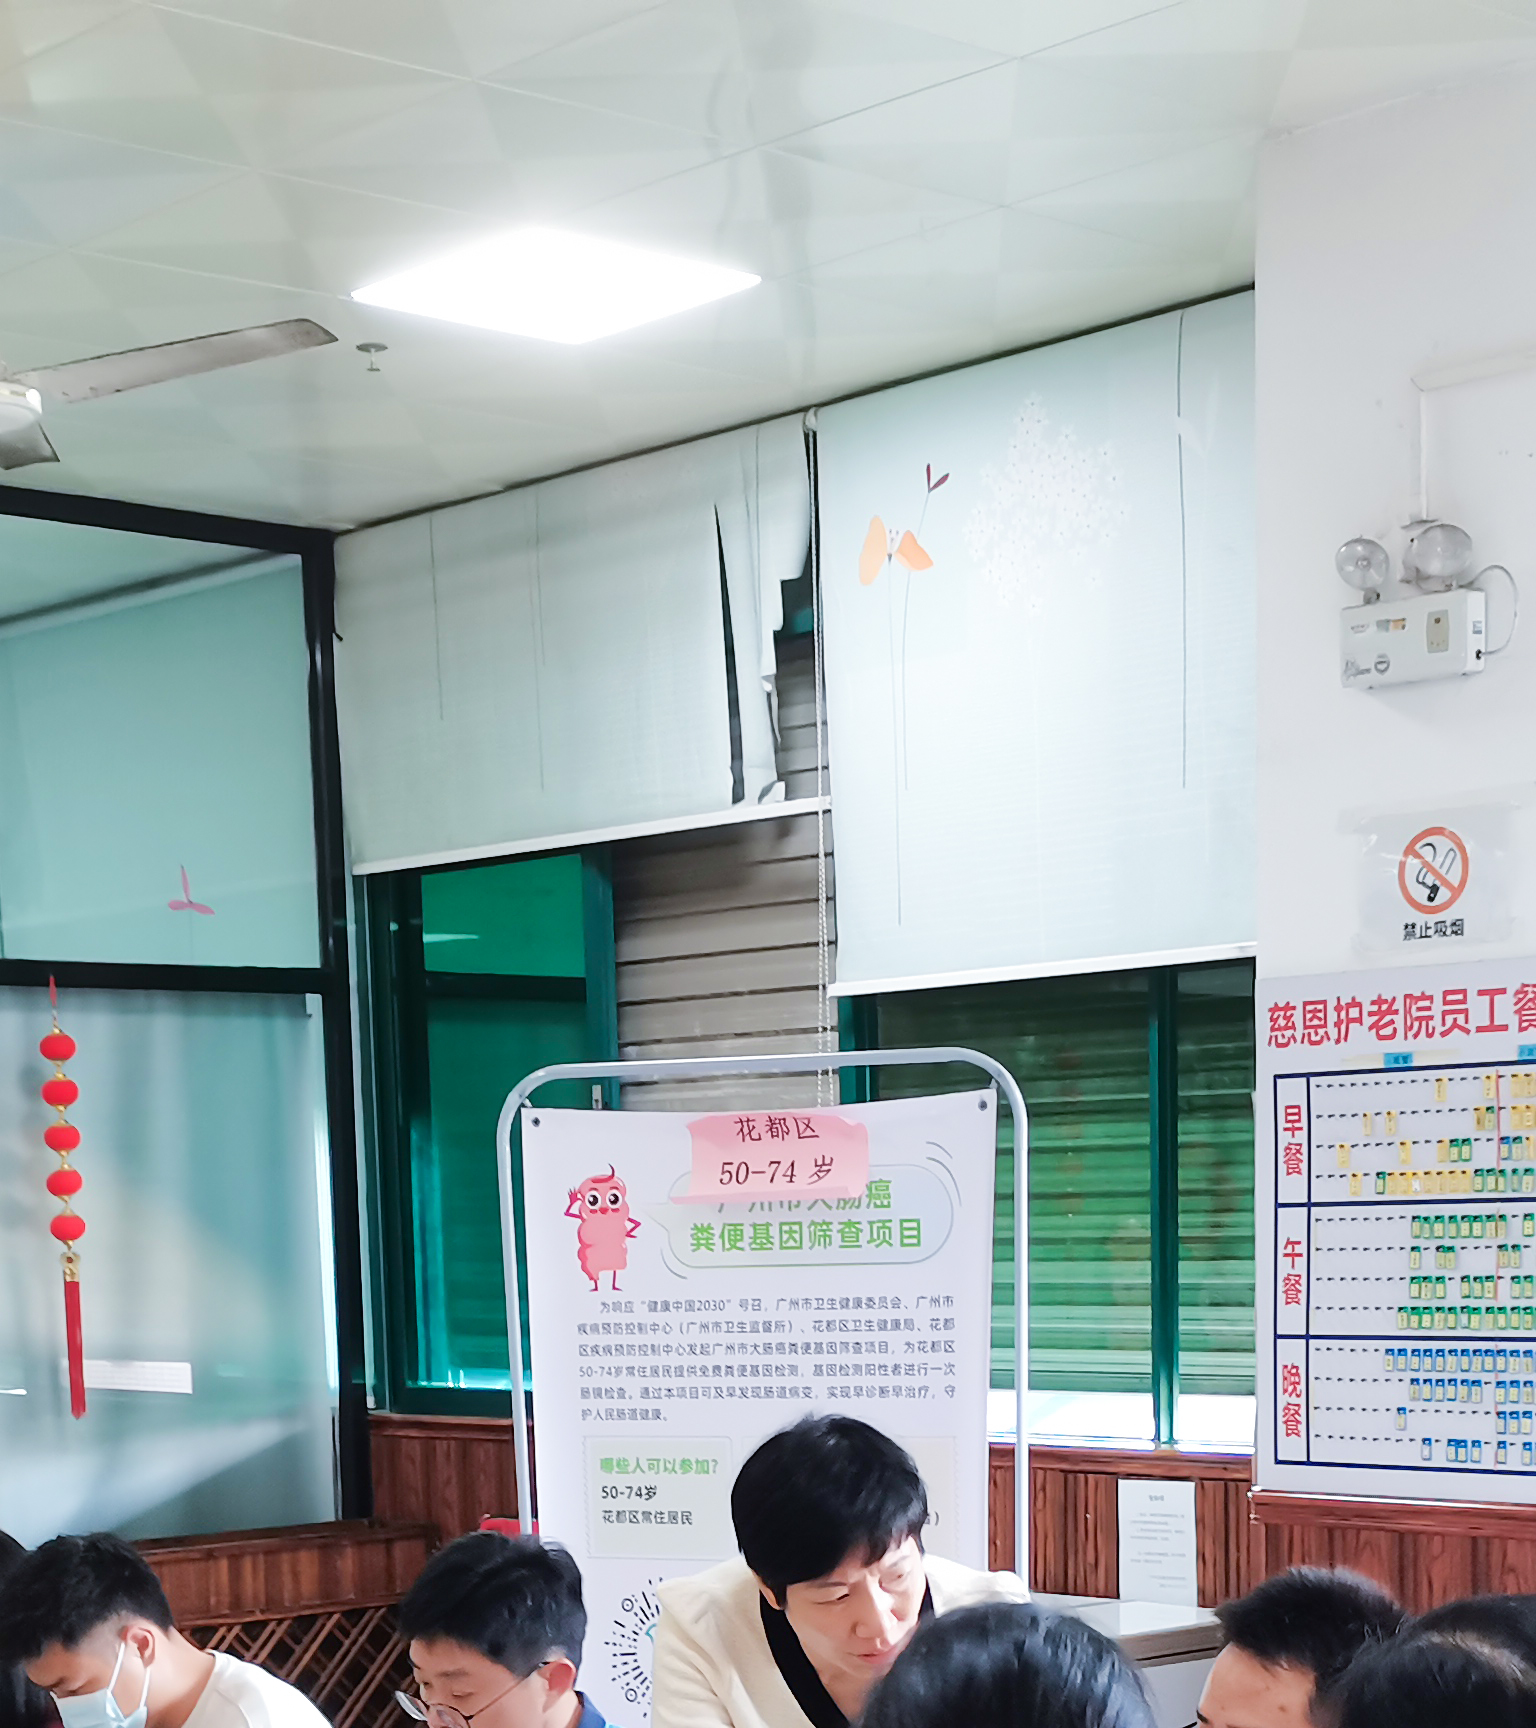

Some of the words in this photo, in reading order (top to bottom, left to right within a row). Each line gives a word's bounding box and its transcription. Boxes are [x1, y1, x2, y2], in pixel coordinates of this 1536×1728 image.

[1402, 918, 1465, 941] 禁止吸烟
[734, 1116, 820, 1142] 花都区
[1283, 1105, 1304, 1176] 早餐
[718, 1159, 797, 1185] 50-74
[806, 1154, 834, 1185] 岁
[689, 1218, 922, 1252] 粪便基因筛查项目
[1282, 1237, 1304, 1306] 午餐
[1281, 1363, 1303, 1438] 晚餐
[601, 1484, 658, 1501] 50-74岁
[602, 1510, 694, 1525] 花都区常住居民
